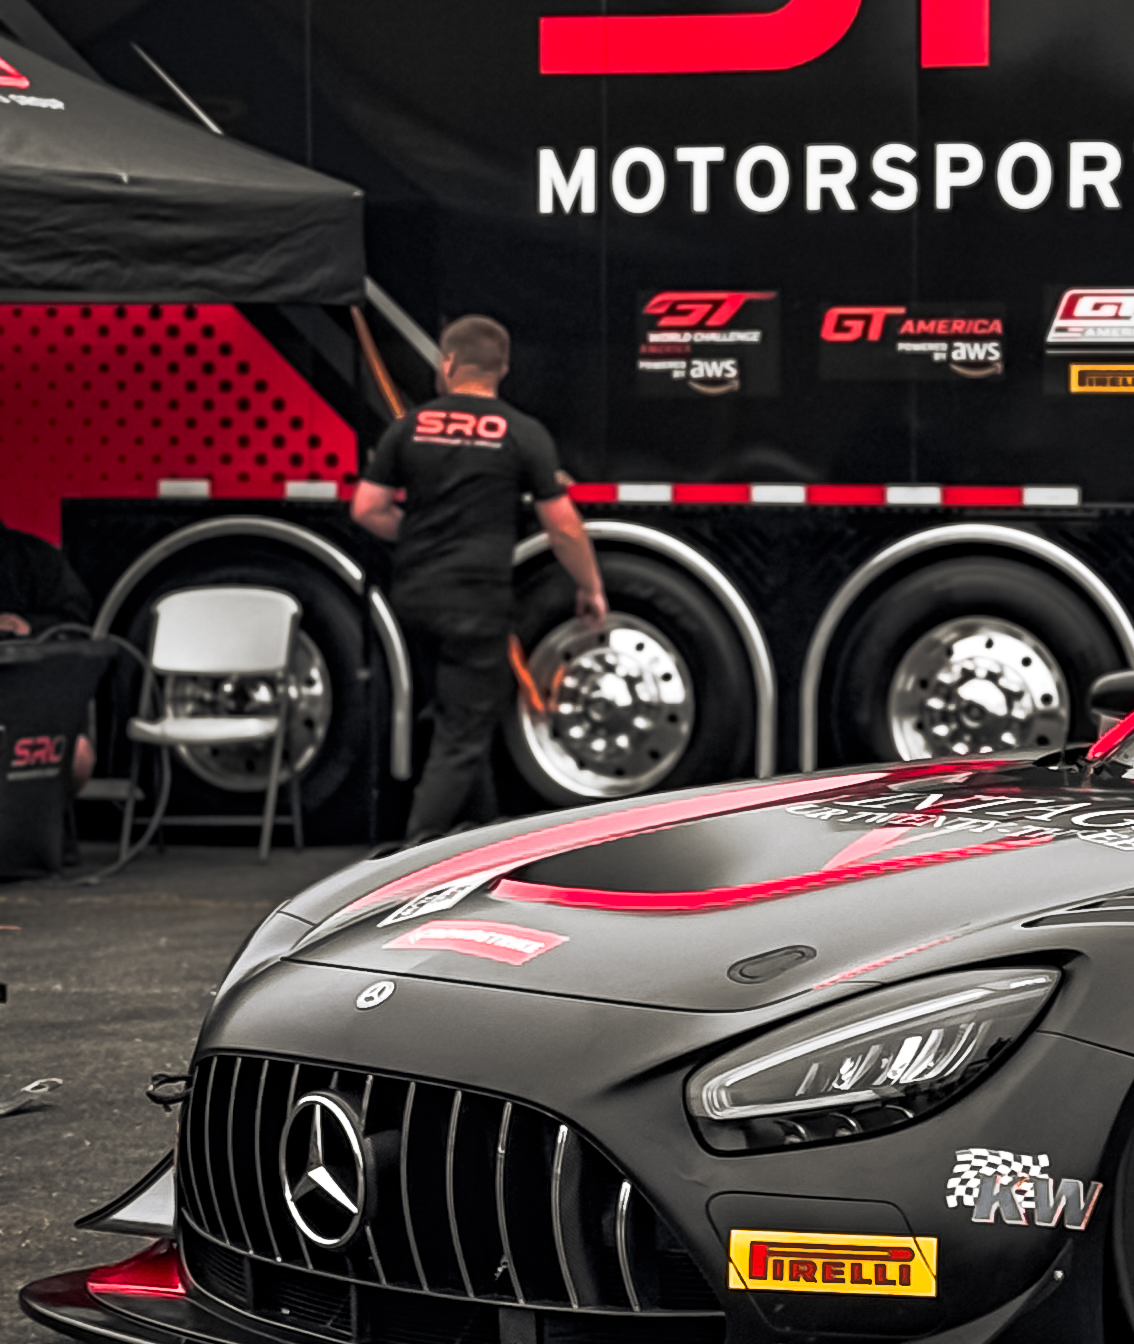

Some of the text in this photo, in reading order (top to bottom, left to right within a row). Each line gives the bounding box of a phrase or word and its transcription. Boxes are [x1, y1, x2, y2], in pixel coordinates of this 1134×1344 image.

[819, 306, 1004, 342] GT AMERICA
[950, 341, 1002, 361] aws
[689, 359, 739, 379] aws
[415, 410, 508, 439] SRO
[972, 1173, 1103, 1231] KW
[748, 1241, 916, 1287] PIRELLI
